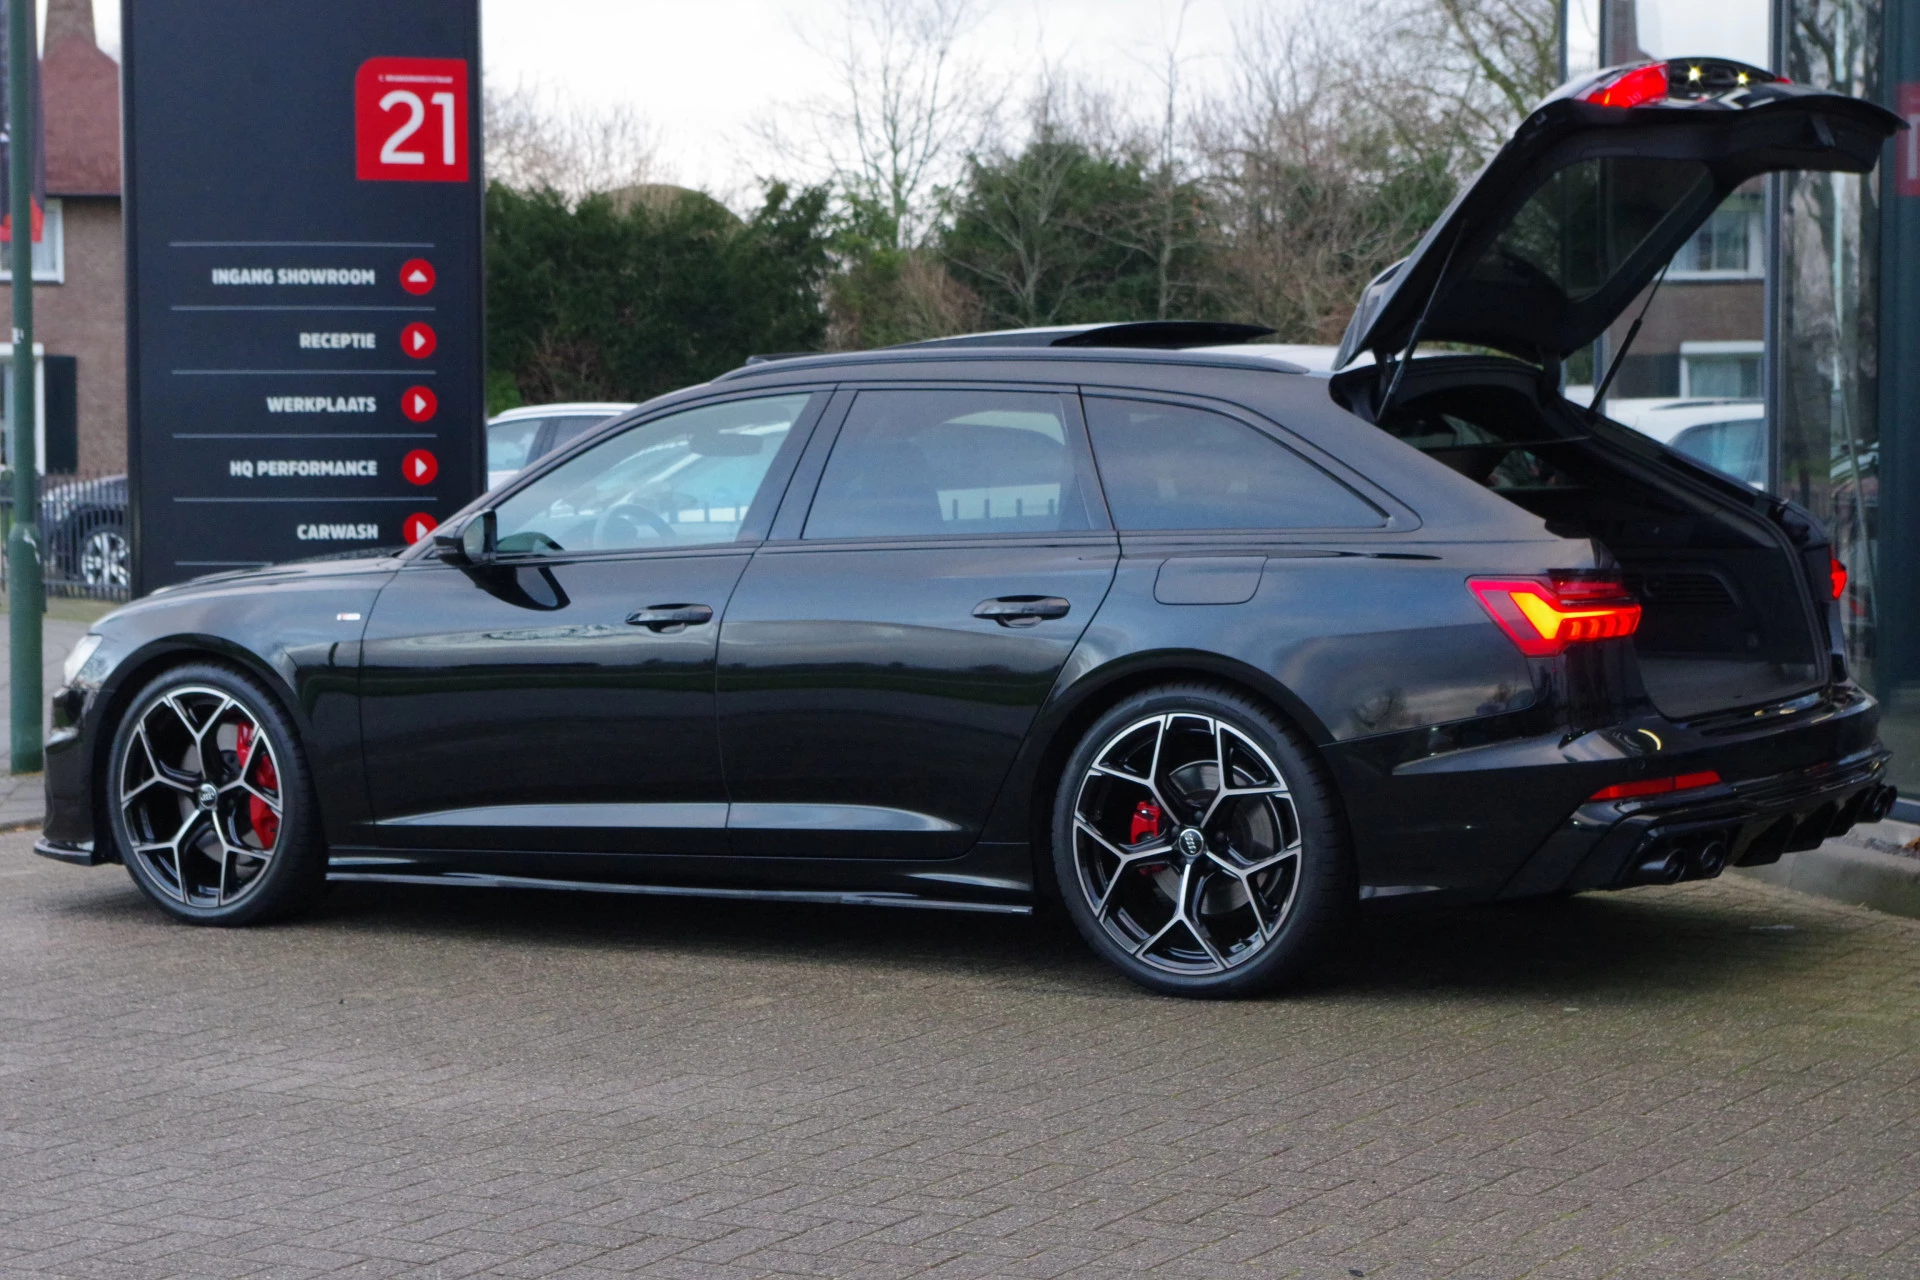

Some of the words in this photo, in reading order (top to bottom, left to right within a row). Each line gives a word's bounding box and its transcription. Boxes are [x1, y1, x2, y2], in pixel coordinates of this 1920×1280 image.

[378, 89, 456, 166] 21
[211, 268, 275, 285] INGANG
[277, 268, 376, 286] SHOWROOM
[299, 332, 376, 349] RECEPTIE
[266, 396, 377, 413] WERKPLAATS
[229, 460, 254, 478] HQ
[256, 460, 378, 477] PERFORMANCE
[296, 523, 379, 540] CARWASH
